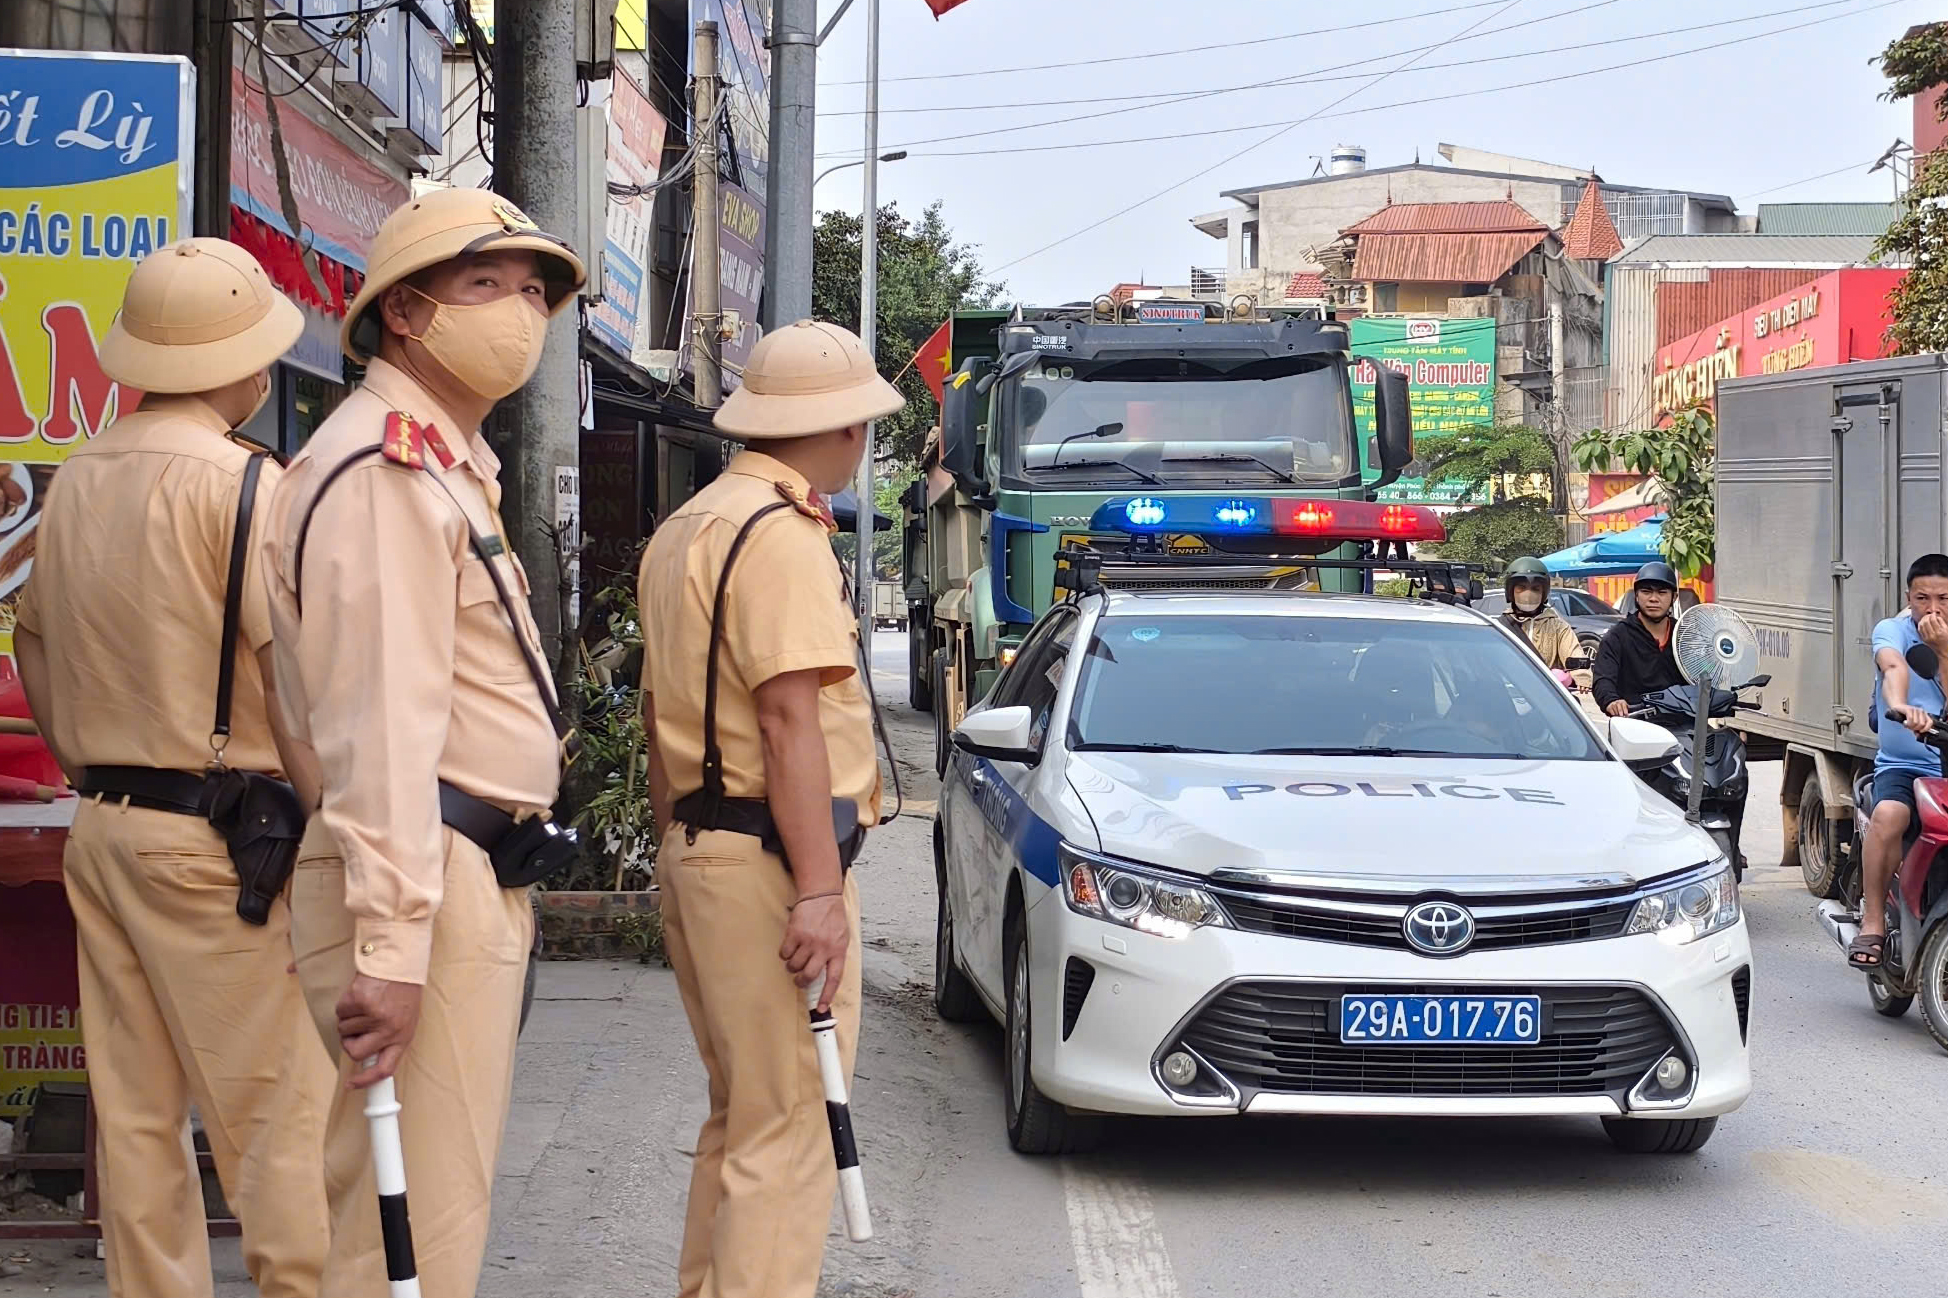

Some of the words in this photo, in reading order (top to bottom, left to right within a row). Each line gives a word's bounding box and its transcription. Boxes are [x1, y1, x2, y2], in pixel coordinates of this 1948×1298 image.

[0, 204, 70, 255] CÁC
[722, 191, 739, 231] EVA
[739, 205, 760, 243] SHOP
[1141, 306, 1202, 321] SINOTRUK
[1417, 359, 1490, 386] Computer
[1222, 782, 1566, 806] POLICE
[1347, 1000, 1533, 1038] 29A-017.76
[2, 1040, 87, 1070] TRÀNG
